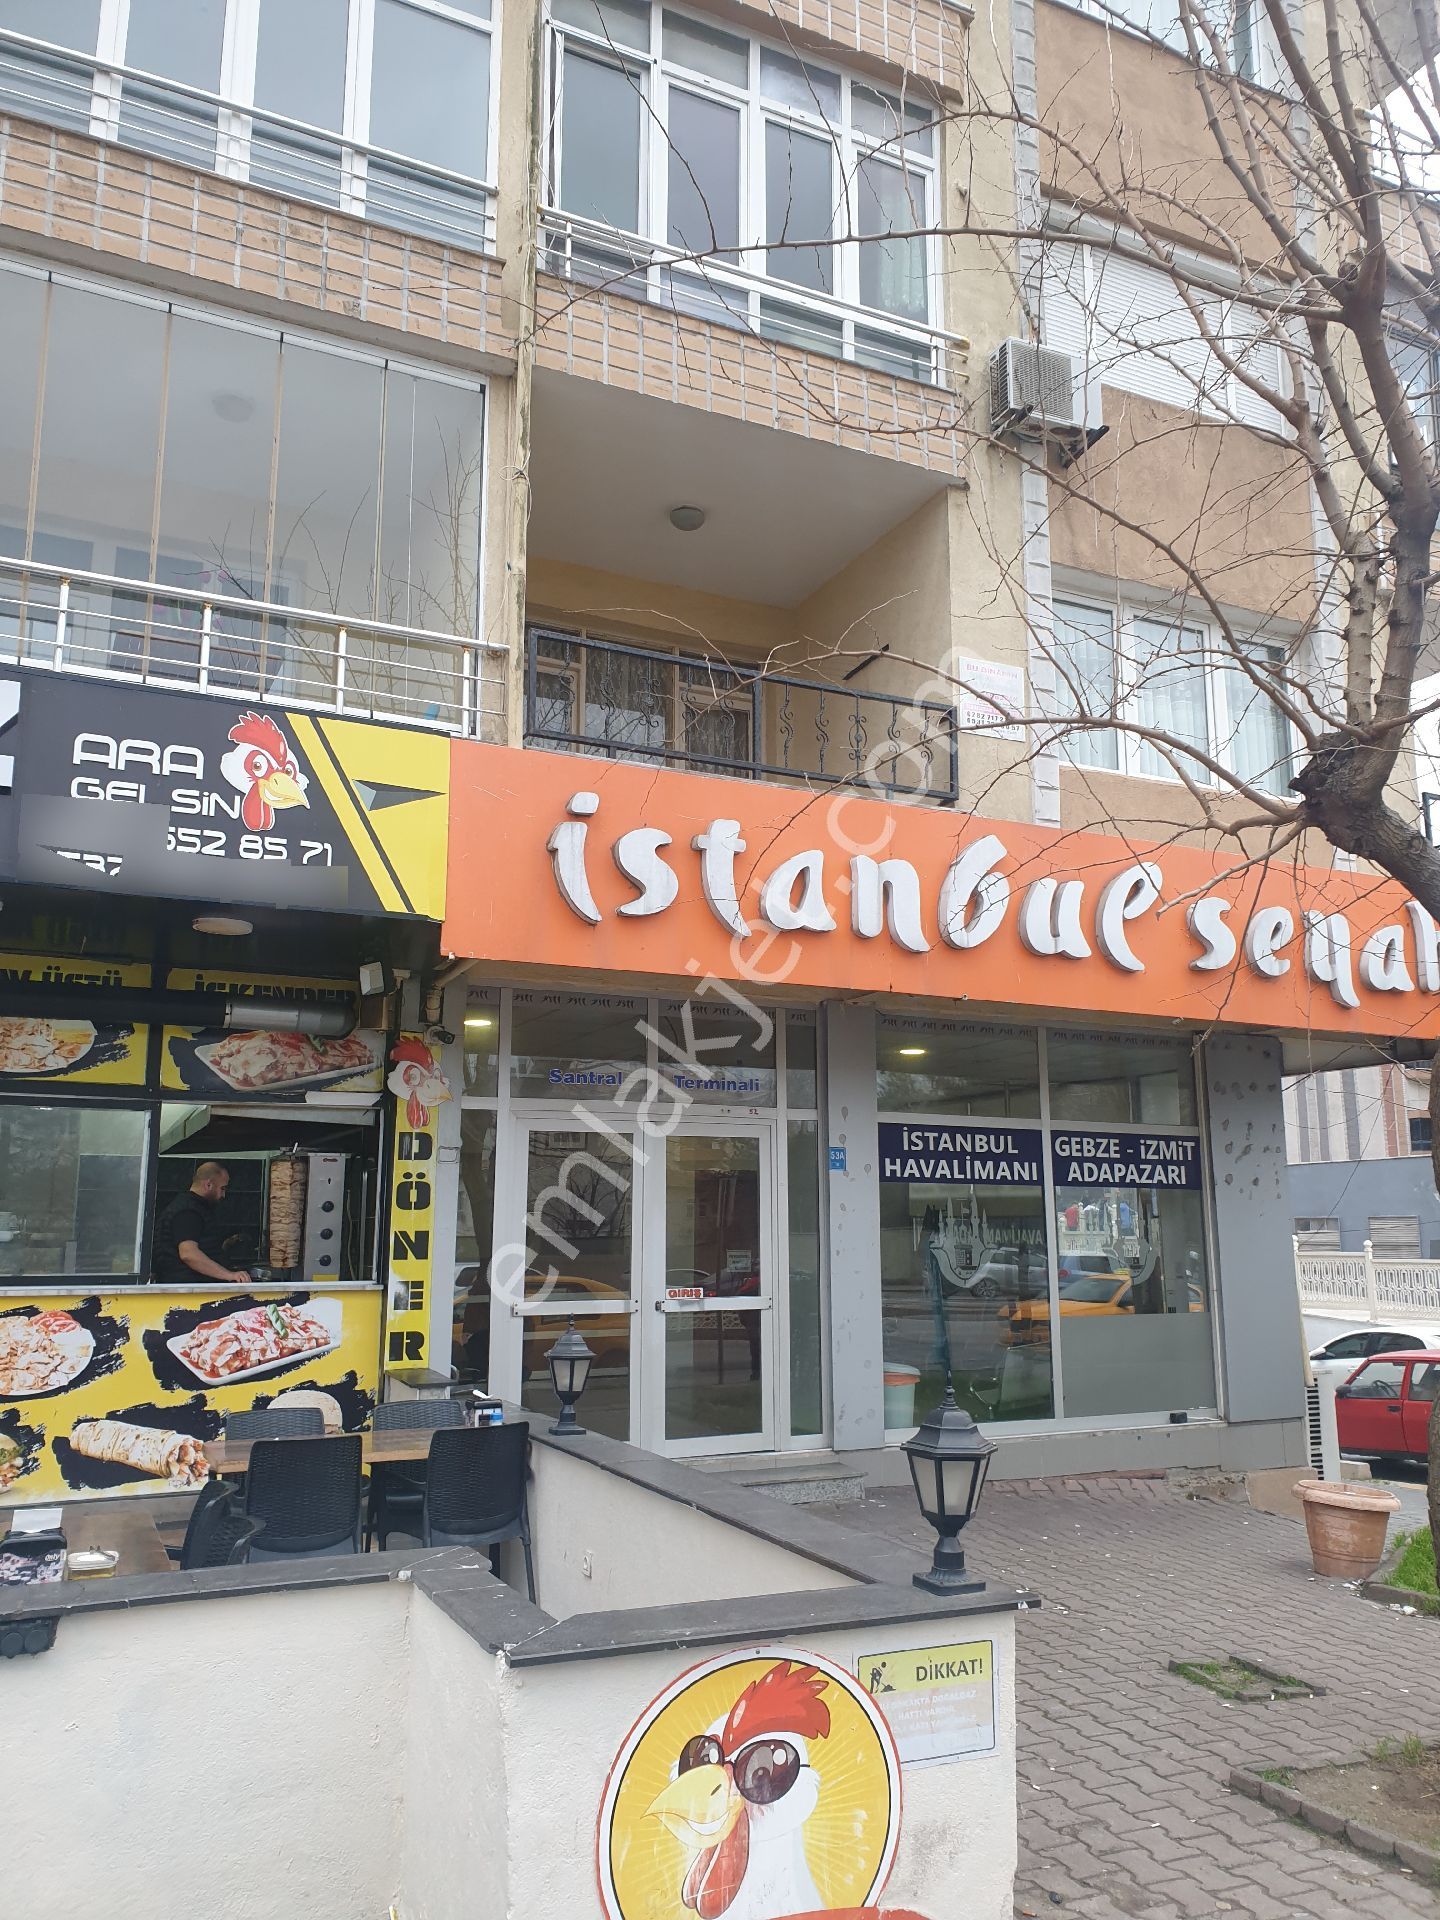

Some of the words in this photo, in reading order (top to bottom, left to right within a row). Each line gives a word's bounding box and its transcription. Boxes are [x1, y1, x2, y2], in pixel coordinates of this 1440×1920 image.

[73, 733, 204, 780] ARA
[238, 834, 288, 861] 85
[300, 840, 333, 867] 71
[546, 790, 1163, 973] istanbul
[549, 1068, 623, 1086] Santral
[673, 1074, 760, 1092] Terminali
[902, 1126, 1019, 1155] İSTANBUL
[1054, 1135, 1121, 1159] GEBZE
[884, 1155, 1038, 1182] HAVALİMANI
[1066, 1161, 1186, 1185] ADAPAZARI
[388, 1130, 433, 1363] DÖNER
[916, 1657, 983, 1682] DİKKAT!
